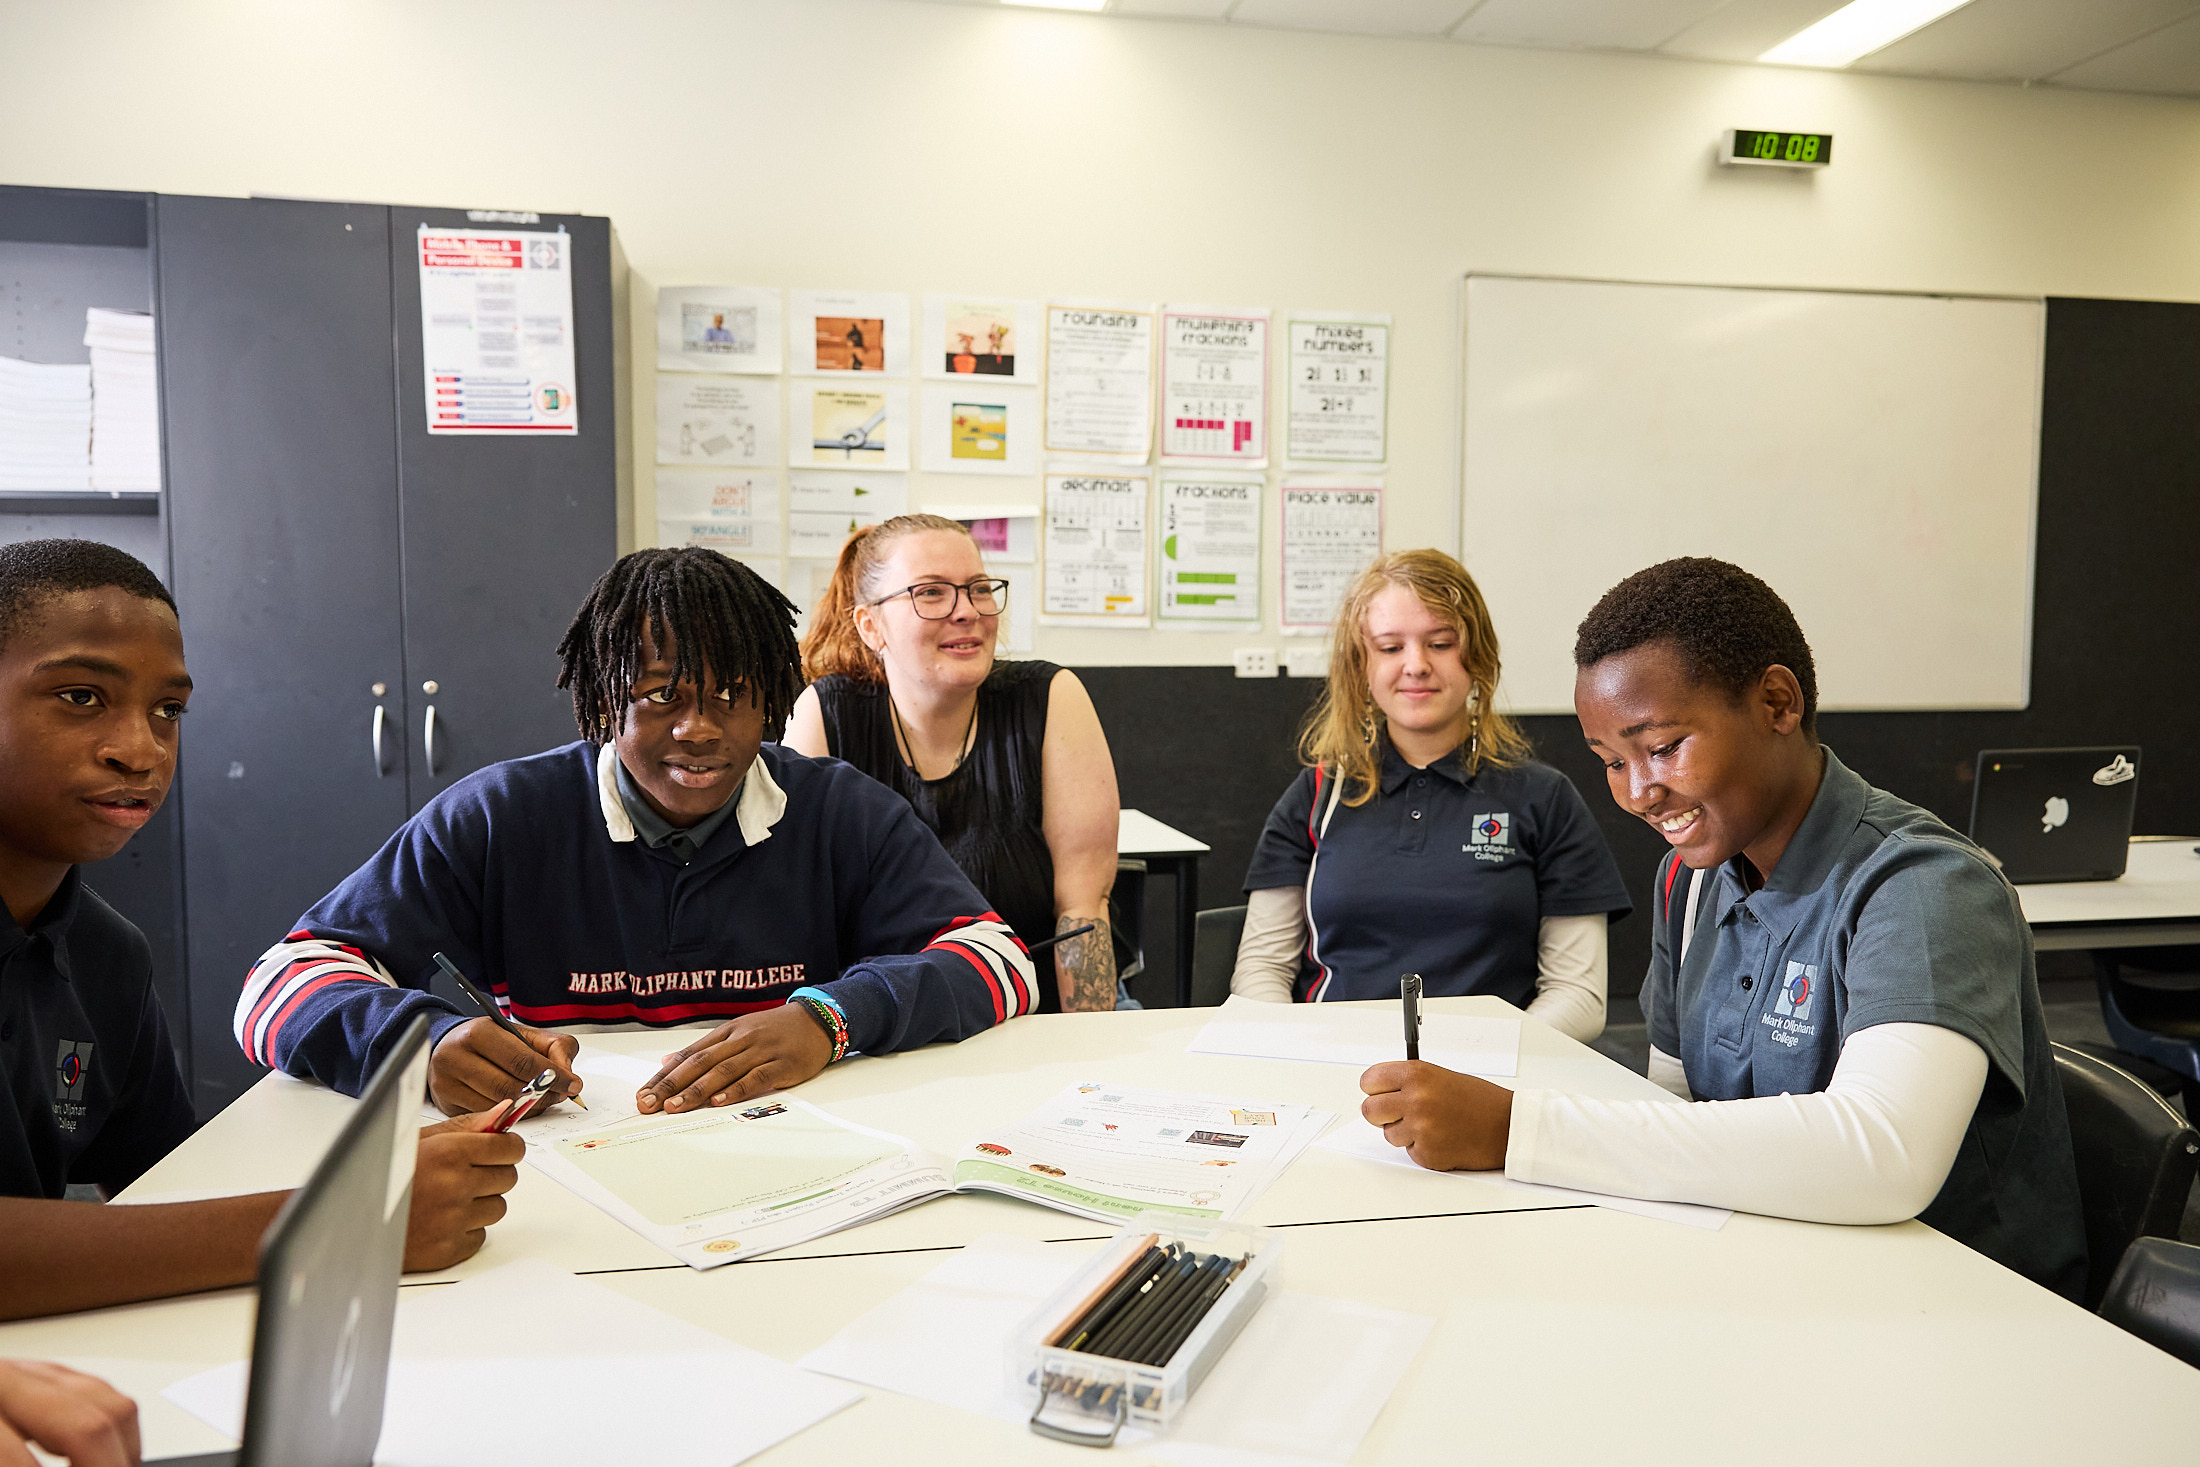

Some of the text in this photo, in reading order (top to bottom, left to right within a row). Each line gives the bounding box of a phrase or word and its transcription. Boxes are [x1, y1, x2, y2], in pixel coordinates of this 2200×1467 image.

[1062, 312, 1137, 328] rounding
[568, 971, 627, 993] MARK
[721, 964, 805, 990] COLLEGE
[1761, 1012, 1816, 1036] Mark Oliphant
[1771, 1029, 1799, 1048] College
[1043, 1183, 1100, 1204] House
